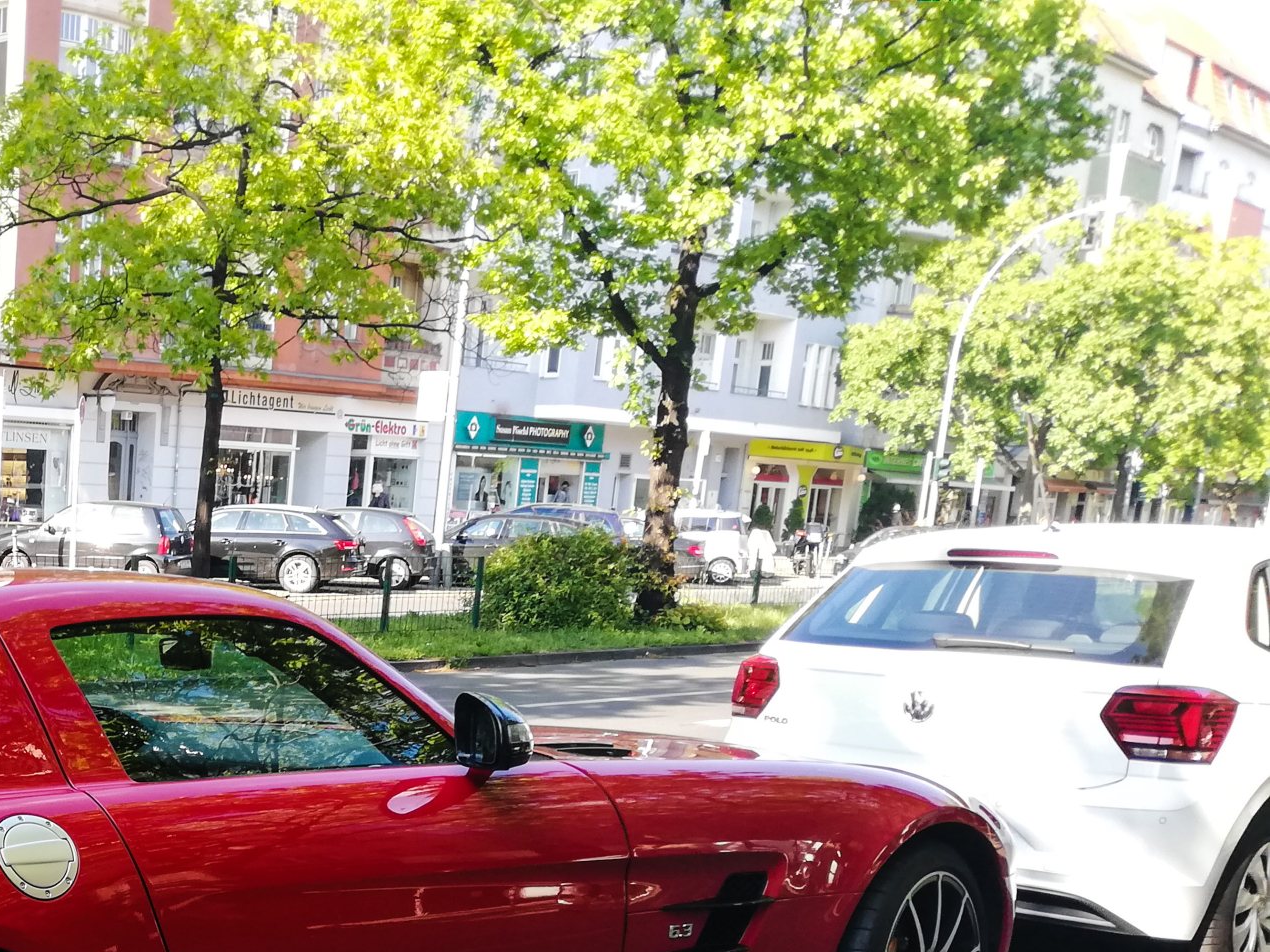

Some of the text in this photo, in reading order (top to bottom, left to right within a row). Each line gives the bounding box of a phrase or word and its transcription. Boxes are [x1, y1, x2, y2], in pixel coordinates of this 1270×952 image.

[231, 389, 294, 410] Lichtagent
[347, 417, 407, 436] Grün-Elektro
[529, 426, 570, 439] PHOTOGRAPHY
[764, 715, 788, 725] POLO
[668, 922, 694, 939] 6.3
